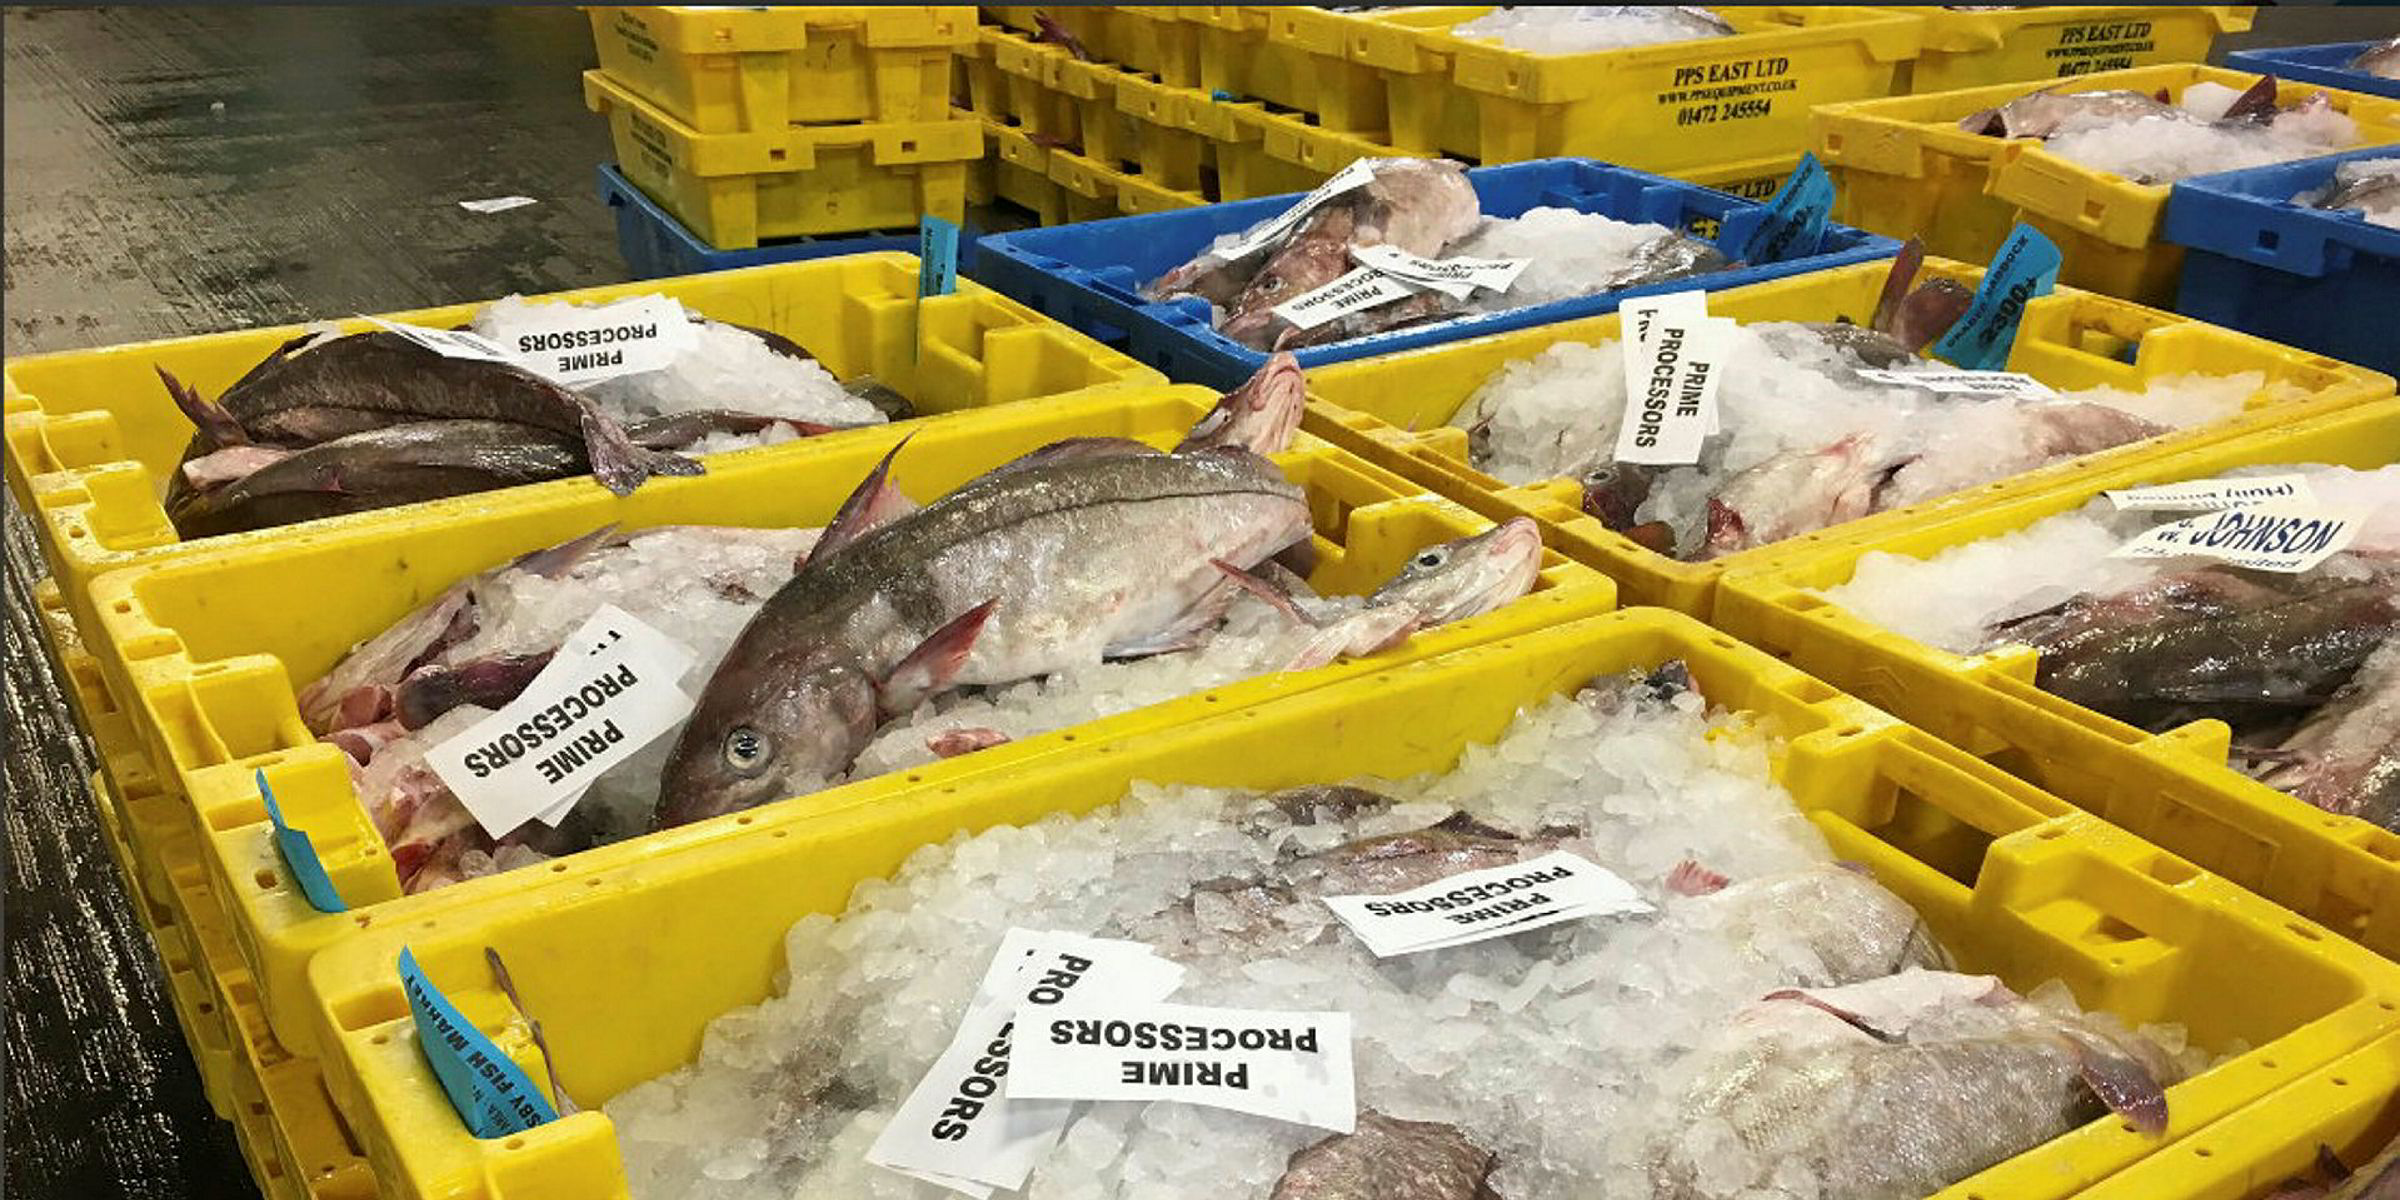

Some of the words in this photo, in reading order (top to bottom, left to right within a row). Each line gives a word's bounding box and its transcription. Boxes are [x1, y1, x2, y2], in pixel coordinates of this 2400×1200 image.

[2087, 25, 2124, 42] EAST
[2123, 22, 2152, 40] LTD
[1673, 66, 1705, 87] PPS
[1708, 61, 1753, 83] EAST
[1756, 57, 1789, 77] LTD
[1677, 103, 1718, 126] 01472
[1721, 98, 1772, 121] 245554
[1292, 268, 1386, 311] ROCESSORS
[1331, 285, 1383, 310] PRIME
[519, 322, 657, 352] PROCESSORS
[559, 350, 623, 373] PRIME
[1635, 328, 1685, 448] PROCESSORS
[1676, 361, 1710, 417] PRIME
[2189, 512, 2344, 554] JOHNSON
[464, 663, 638, 778] PROCESSORS
[535, 718, 625, 784] PRIME
[1364, 866, 1574, 917] PROCESSORS
[1446, 892, 1552, 925] PRIME
[1050, 1019, 1318, 1053] PROCESSORS
[466, 1049, 515, 1094] FISH
[1122, 1061, 1249, 1090] PRIME
